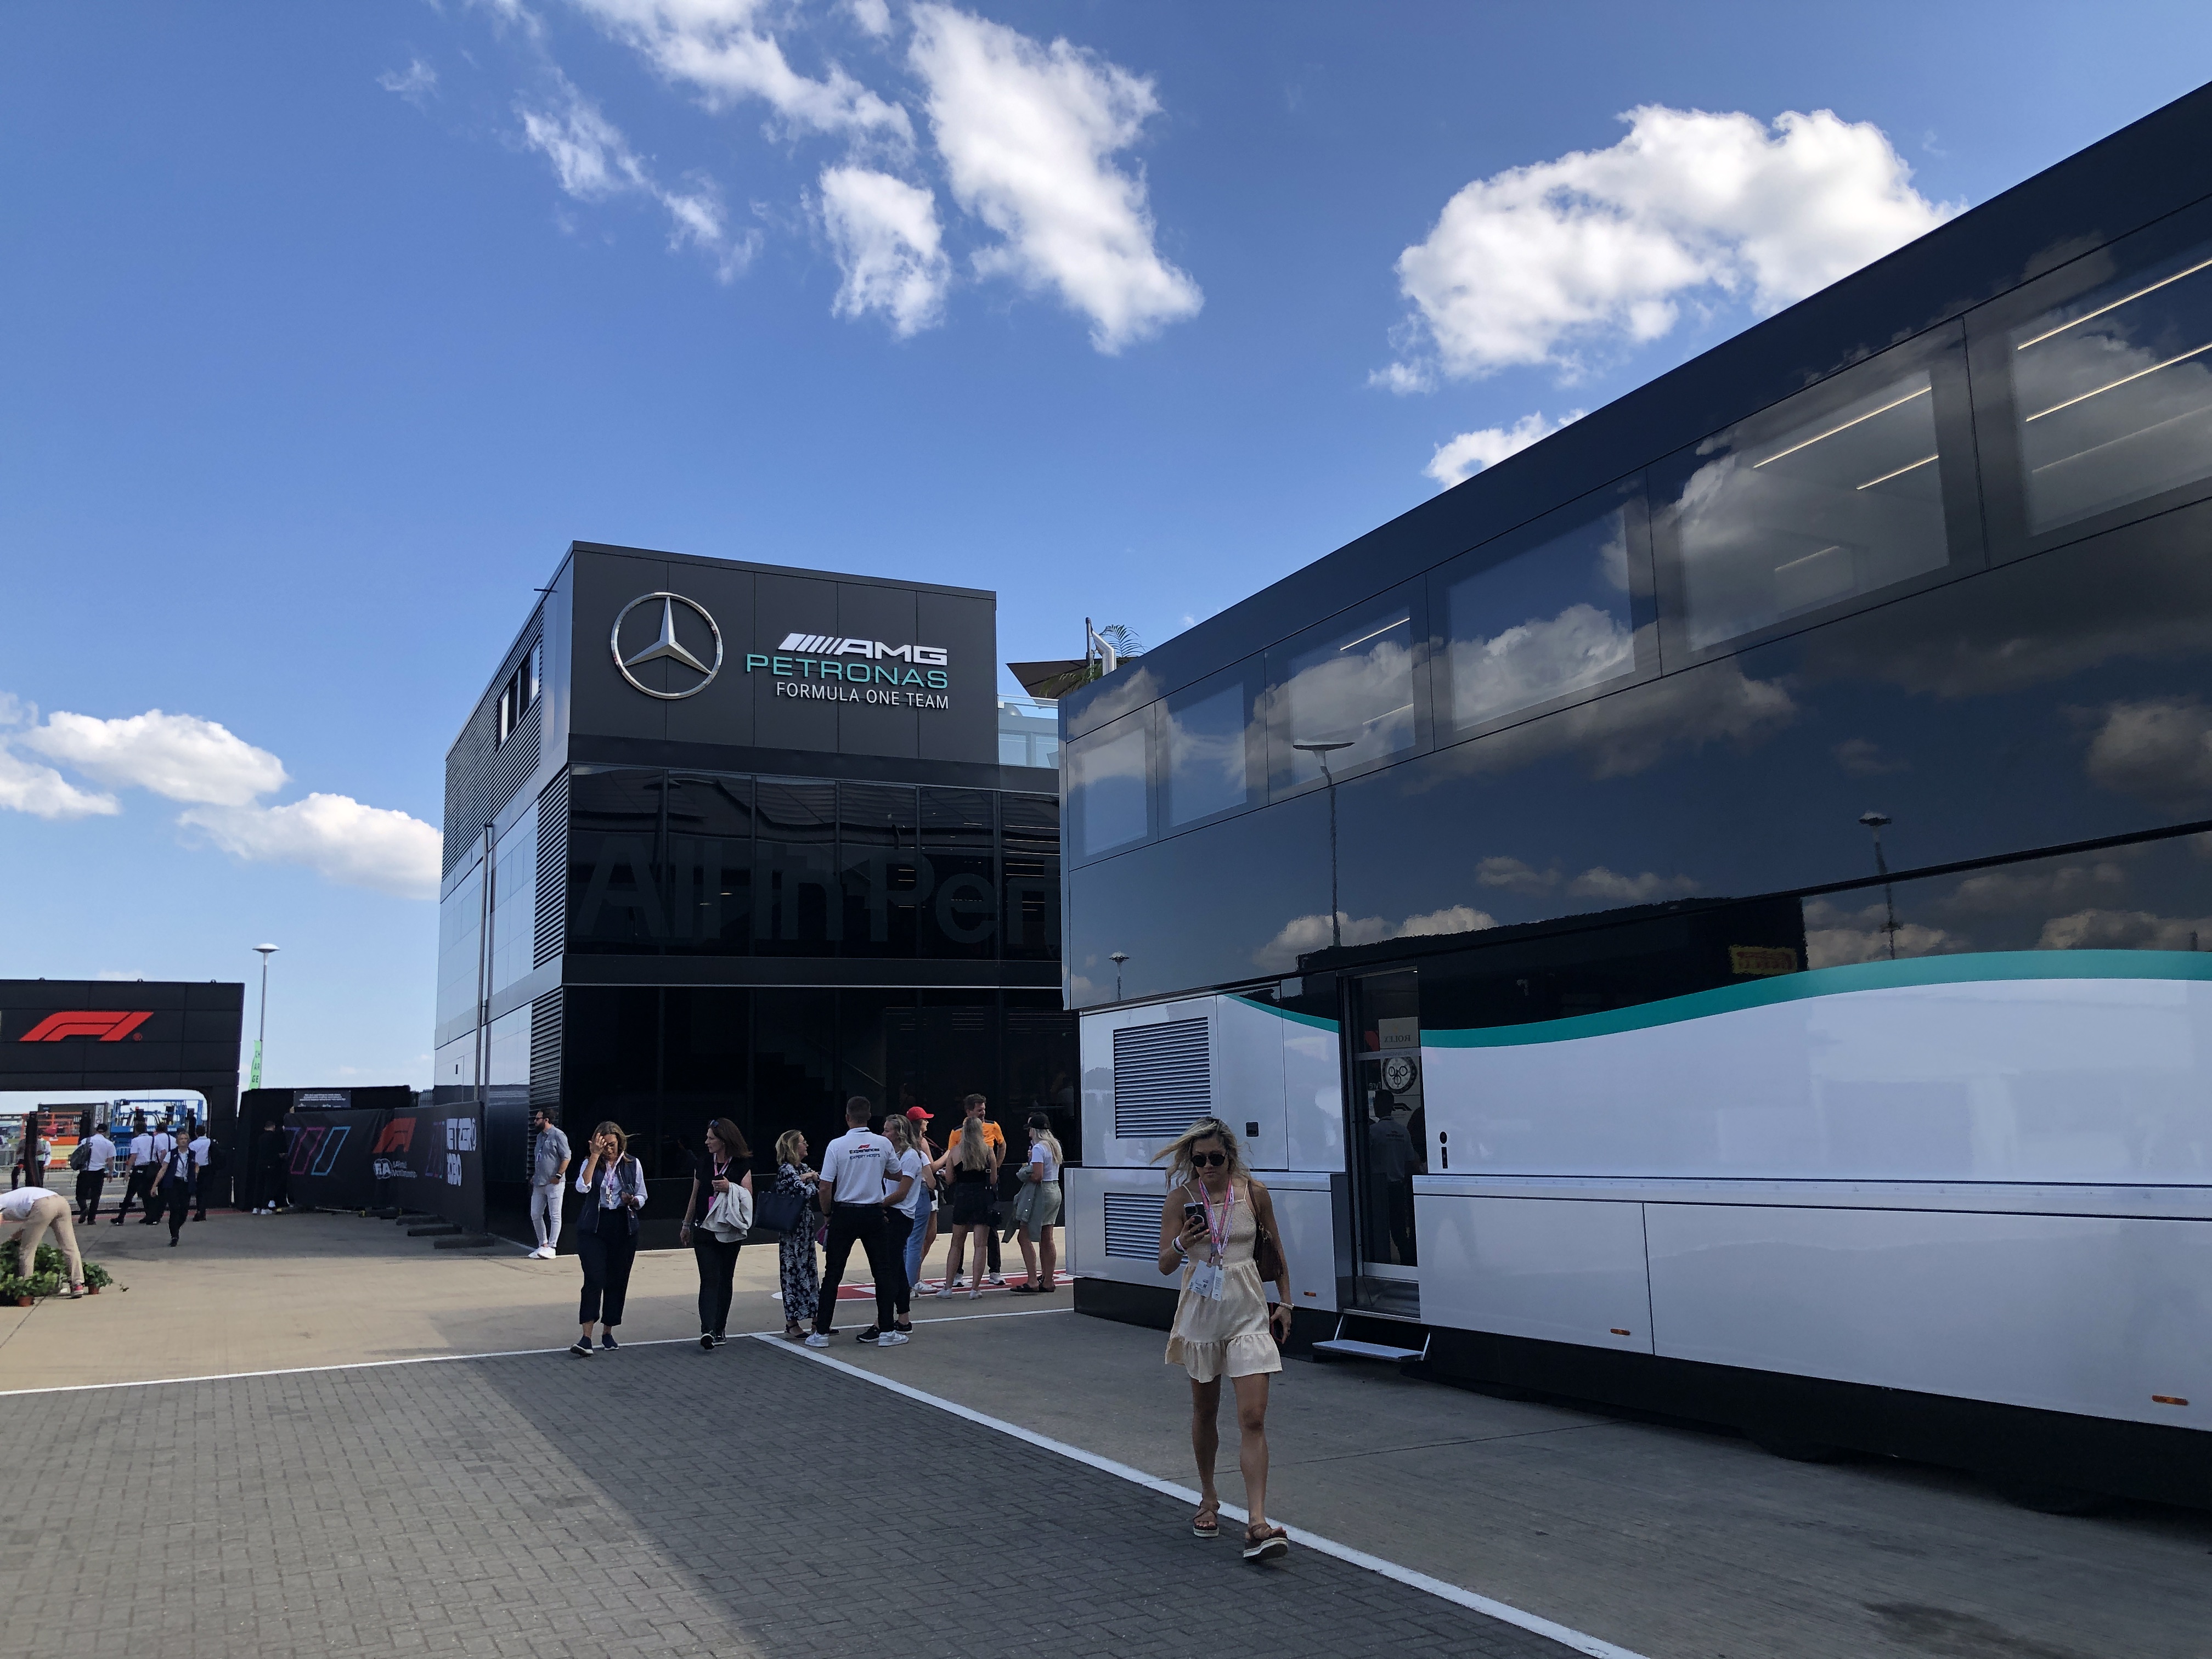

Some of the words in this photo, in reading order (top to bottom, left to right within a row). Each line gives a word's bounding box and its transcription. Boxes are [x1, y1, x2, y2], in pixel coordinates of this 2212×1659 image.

[833, 638, 947, 666] AMG
[747, 653, 949, 689] PETRONAS
[776, 681, 860, 702] FORMULA
[866, 689, 900, 706] ONE
[906, 692, 949, 709] TEAM
[571, 837, 721, 939] All
